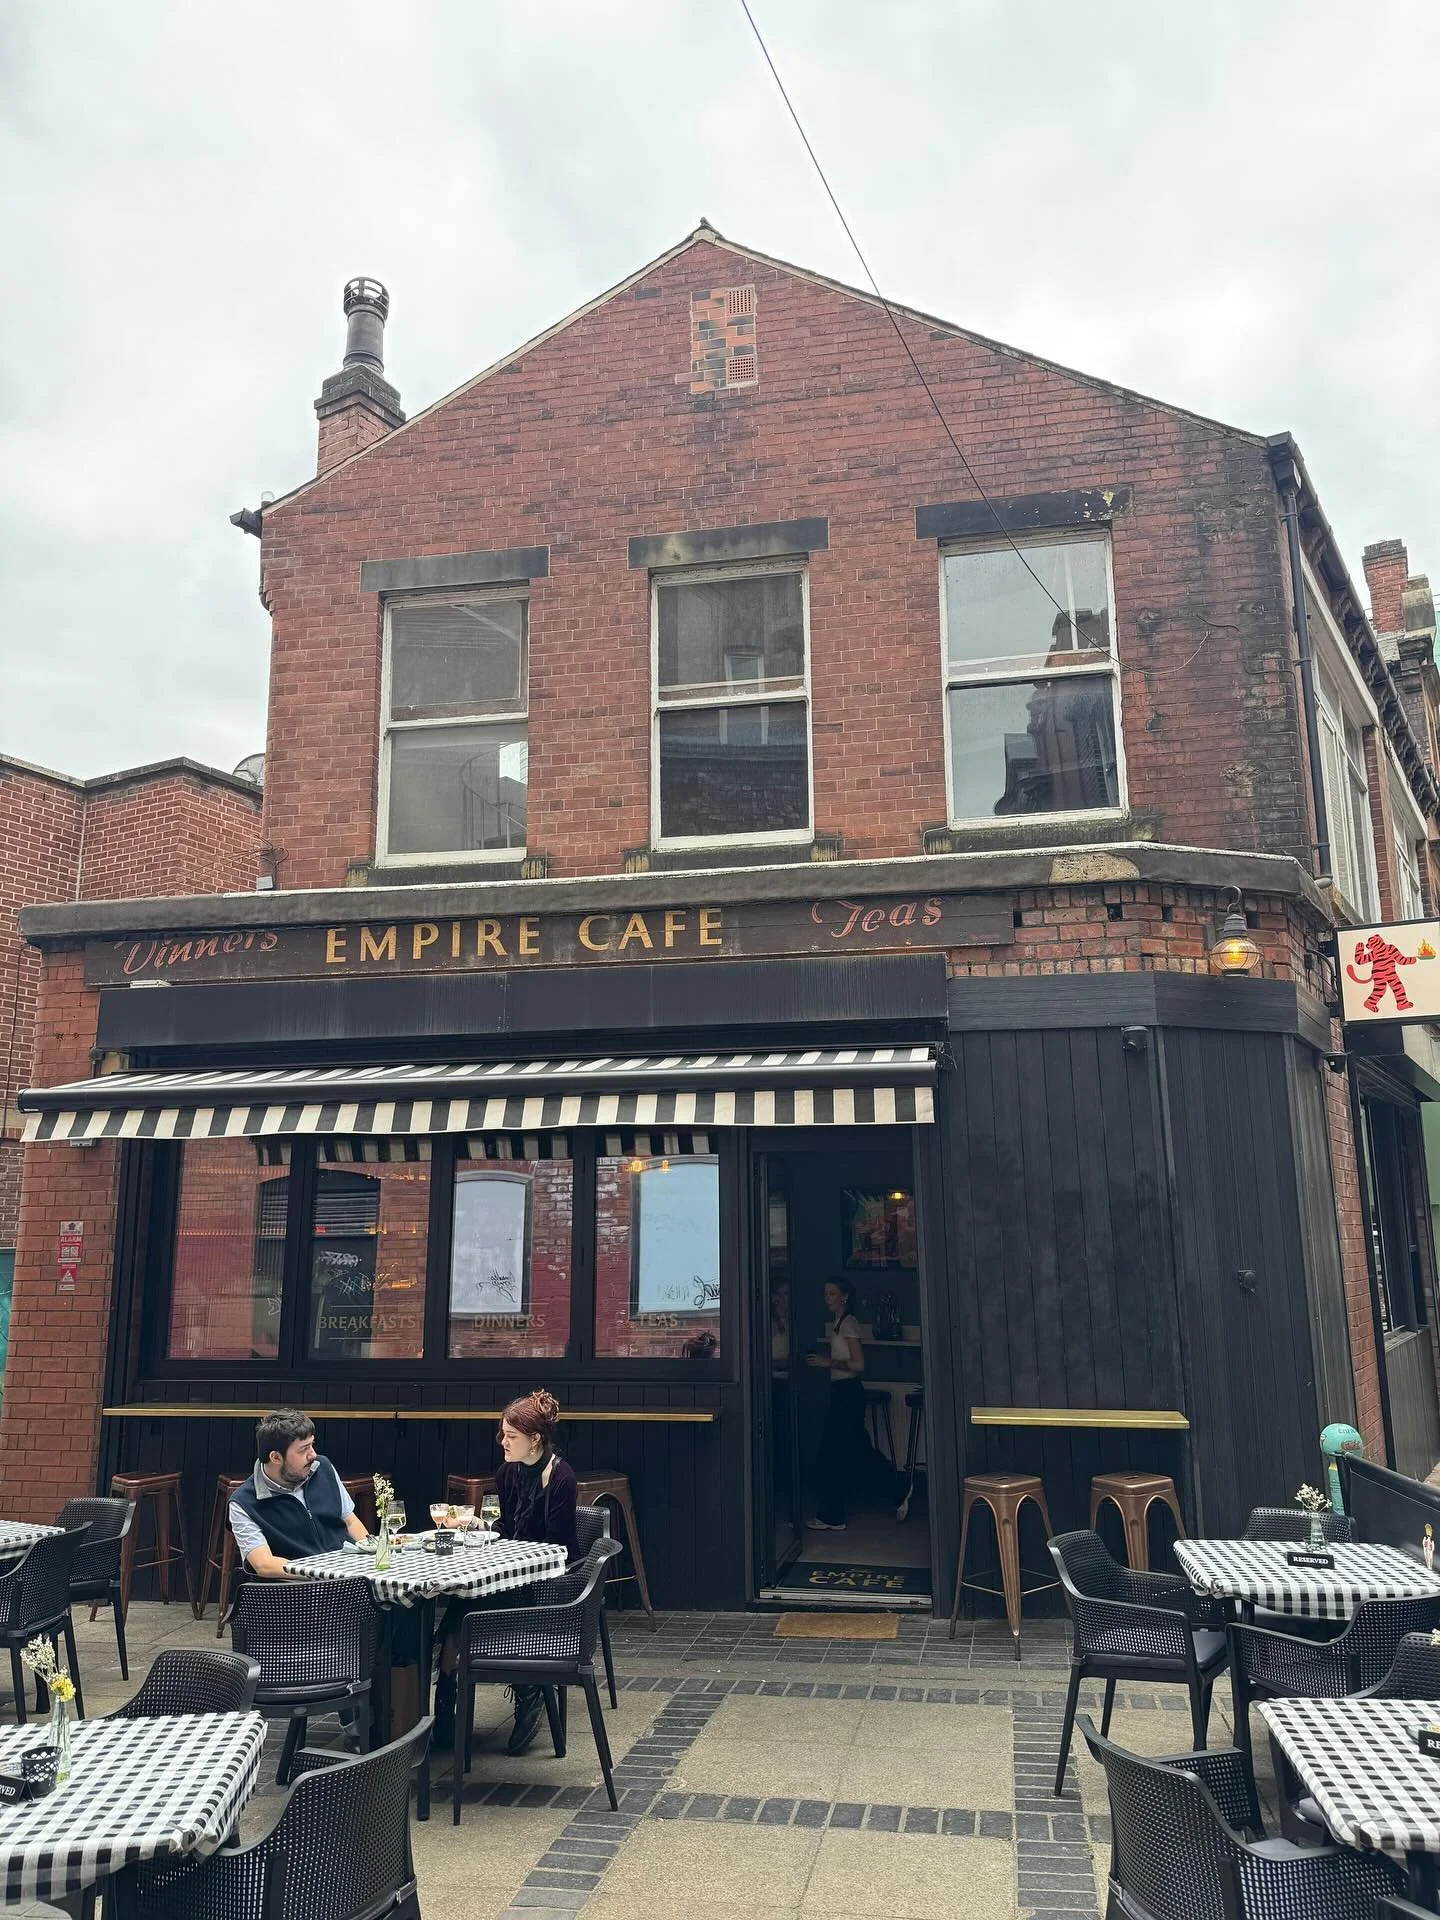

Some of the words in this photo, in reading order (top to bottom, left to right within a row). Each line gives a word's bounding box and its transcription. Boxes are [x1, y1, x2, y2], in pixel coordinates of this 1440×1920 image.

[811, 897, 943, 938] Teas
[326, 917, 540, 963] EMPIRE
[578, 908, 723, 952] CAFE
[317, 1314, 416, 1330] BREAKFASTS
[473, 1313, 546, 1329] DINNERS
[638, 1313, 678, 1327] TEAS
[1293, 1556, 1329, 1565] RESERVED
[808, 1576, 904, 1588] CAFE
[811, 1570, 904, 1580] EMPIRE
